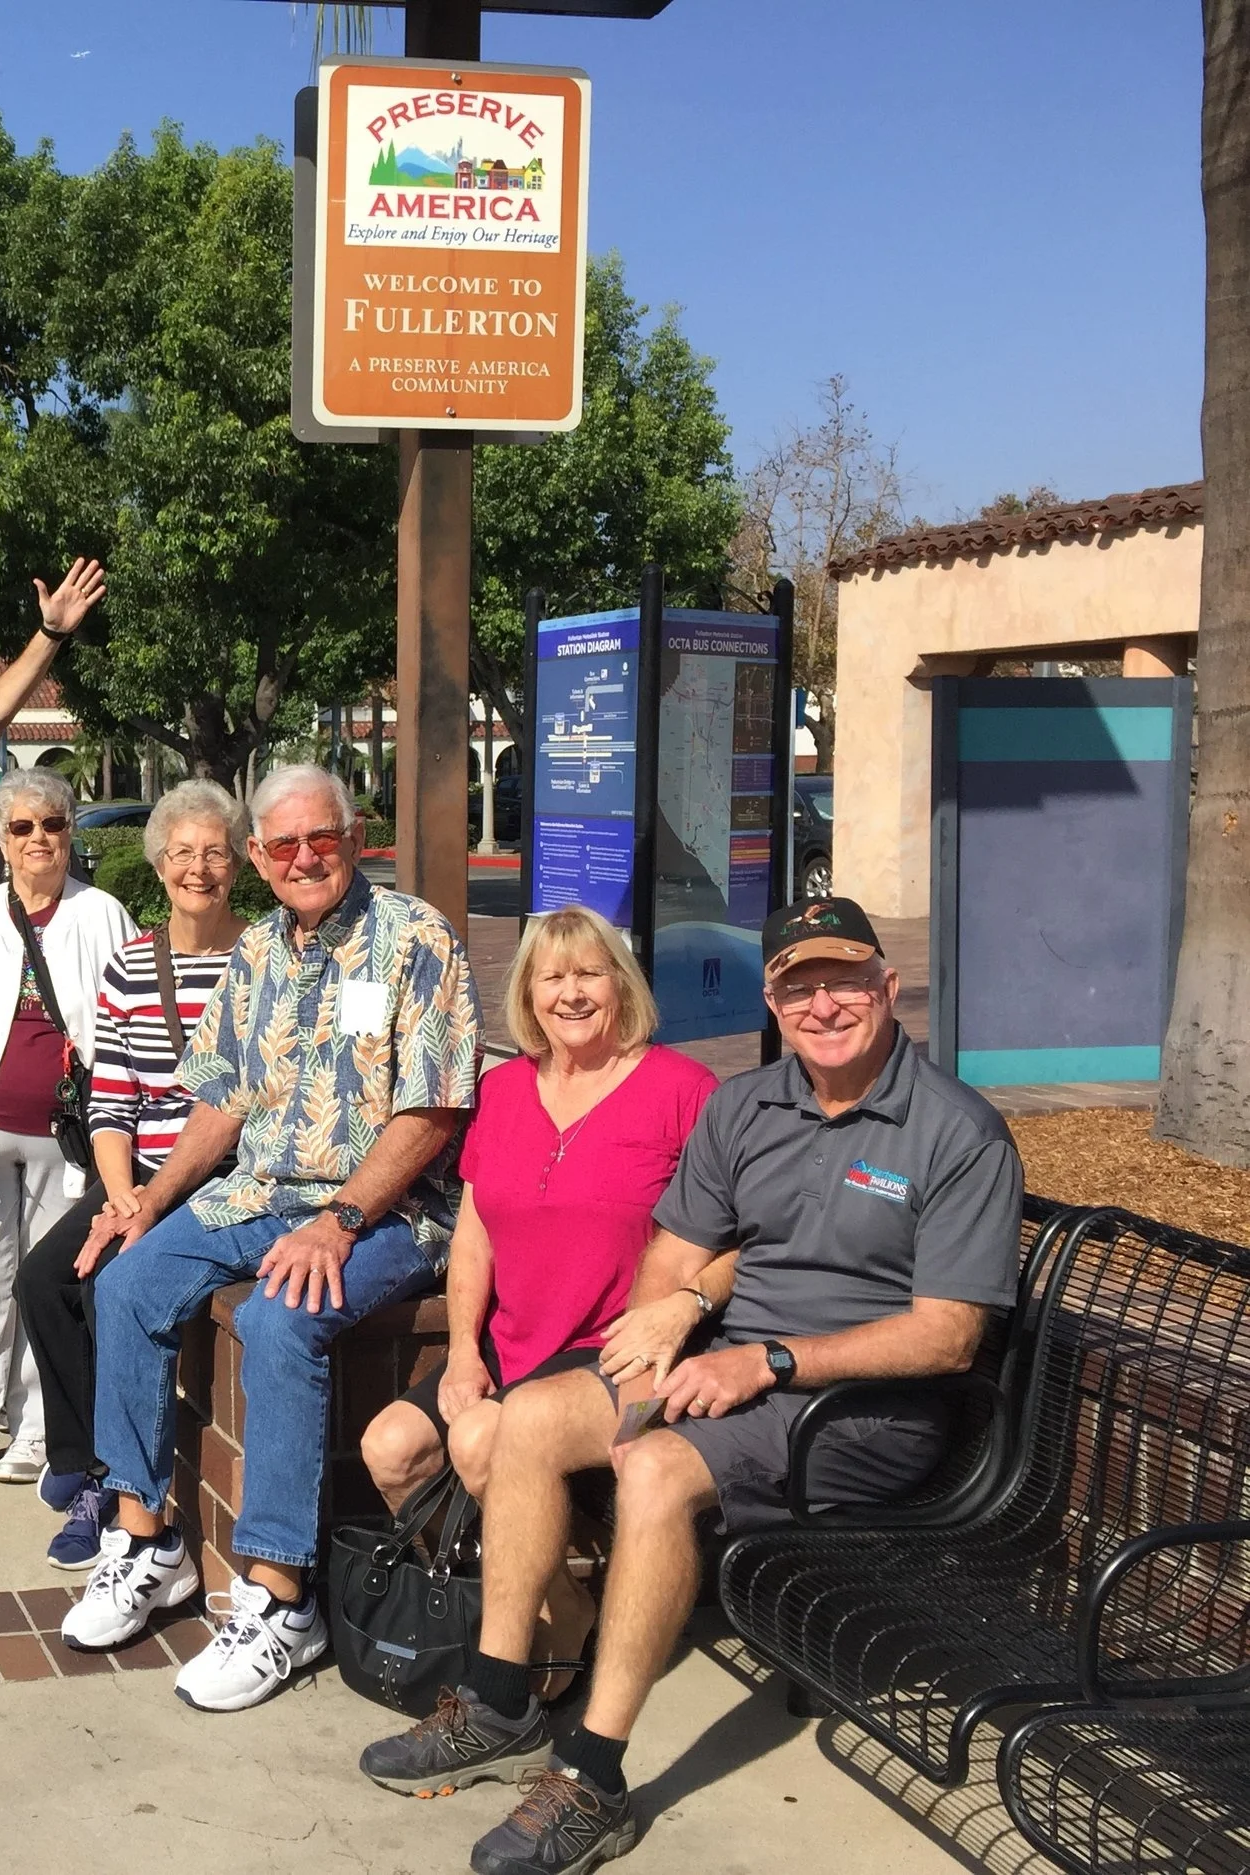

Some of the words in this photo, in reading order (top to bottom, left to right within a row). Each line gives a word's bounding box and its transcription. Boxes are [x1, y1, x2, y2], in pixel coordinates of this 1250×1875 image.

[366, 92, 546, 150] PRESERVE
[368, 192, 541, 222] AMERICA
[347, 222, 398, 243] Explore
[400, 225, 427, 241] and
[431, 226, 468, 246] Enjoy
[472, 228, 501, 243] Our
[504, 228, 560, 249] Heritage
[363, 272, 499, 296] WELCOME
[508, 278, 543, 297] TO
[343, 297, 559, 338] FULLERTON
[348, 356, 363, 373] A
[368, 357, 461, 375] PRESERVE
[466, 360, 551, 377] AMERICA
[391, 377, 510, 395] COMMUNITY
[557, 641, 587, 657] STATION
[587, 638, 622, 654] DIAGRAM
[668, 637, 691, 650] OCTA
[692, 639, 709, 651] BUS
[710, 640, 769, 655] CONNECTIONS
[869, 1175, 908, 1196] PAVILIONS
